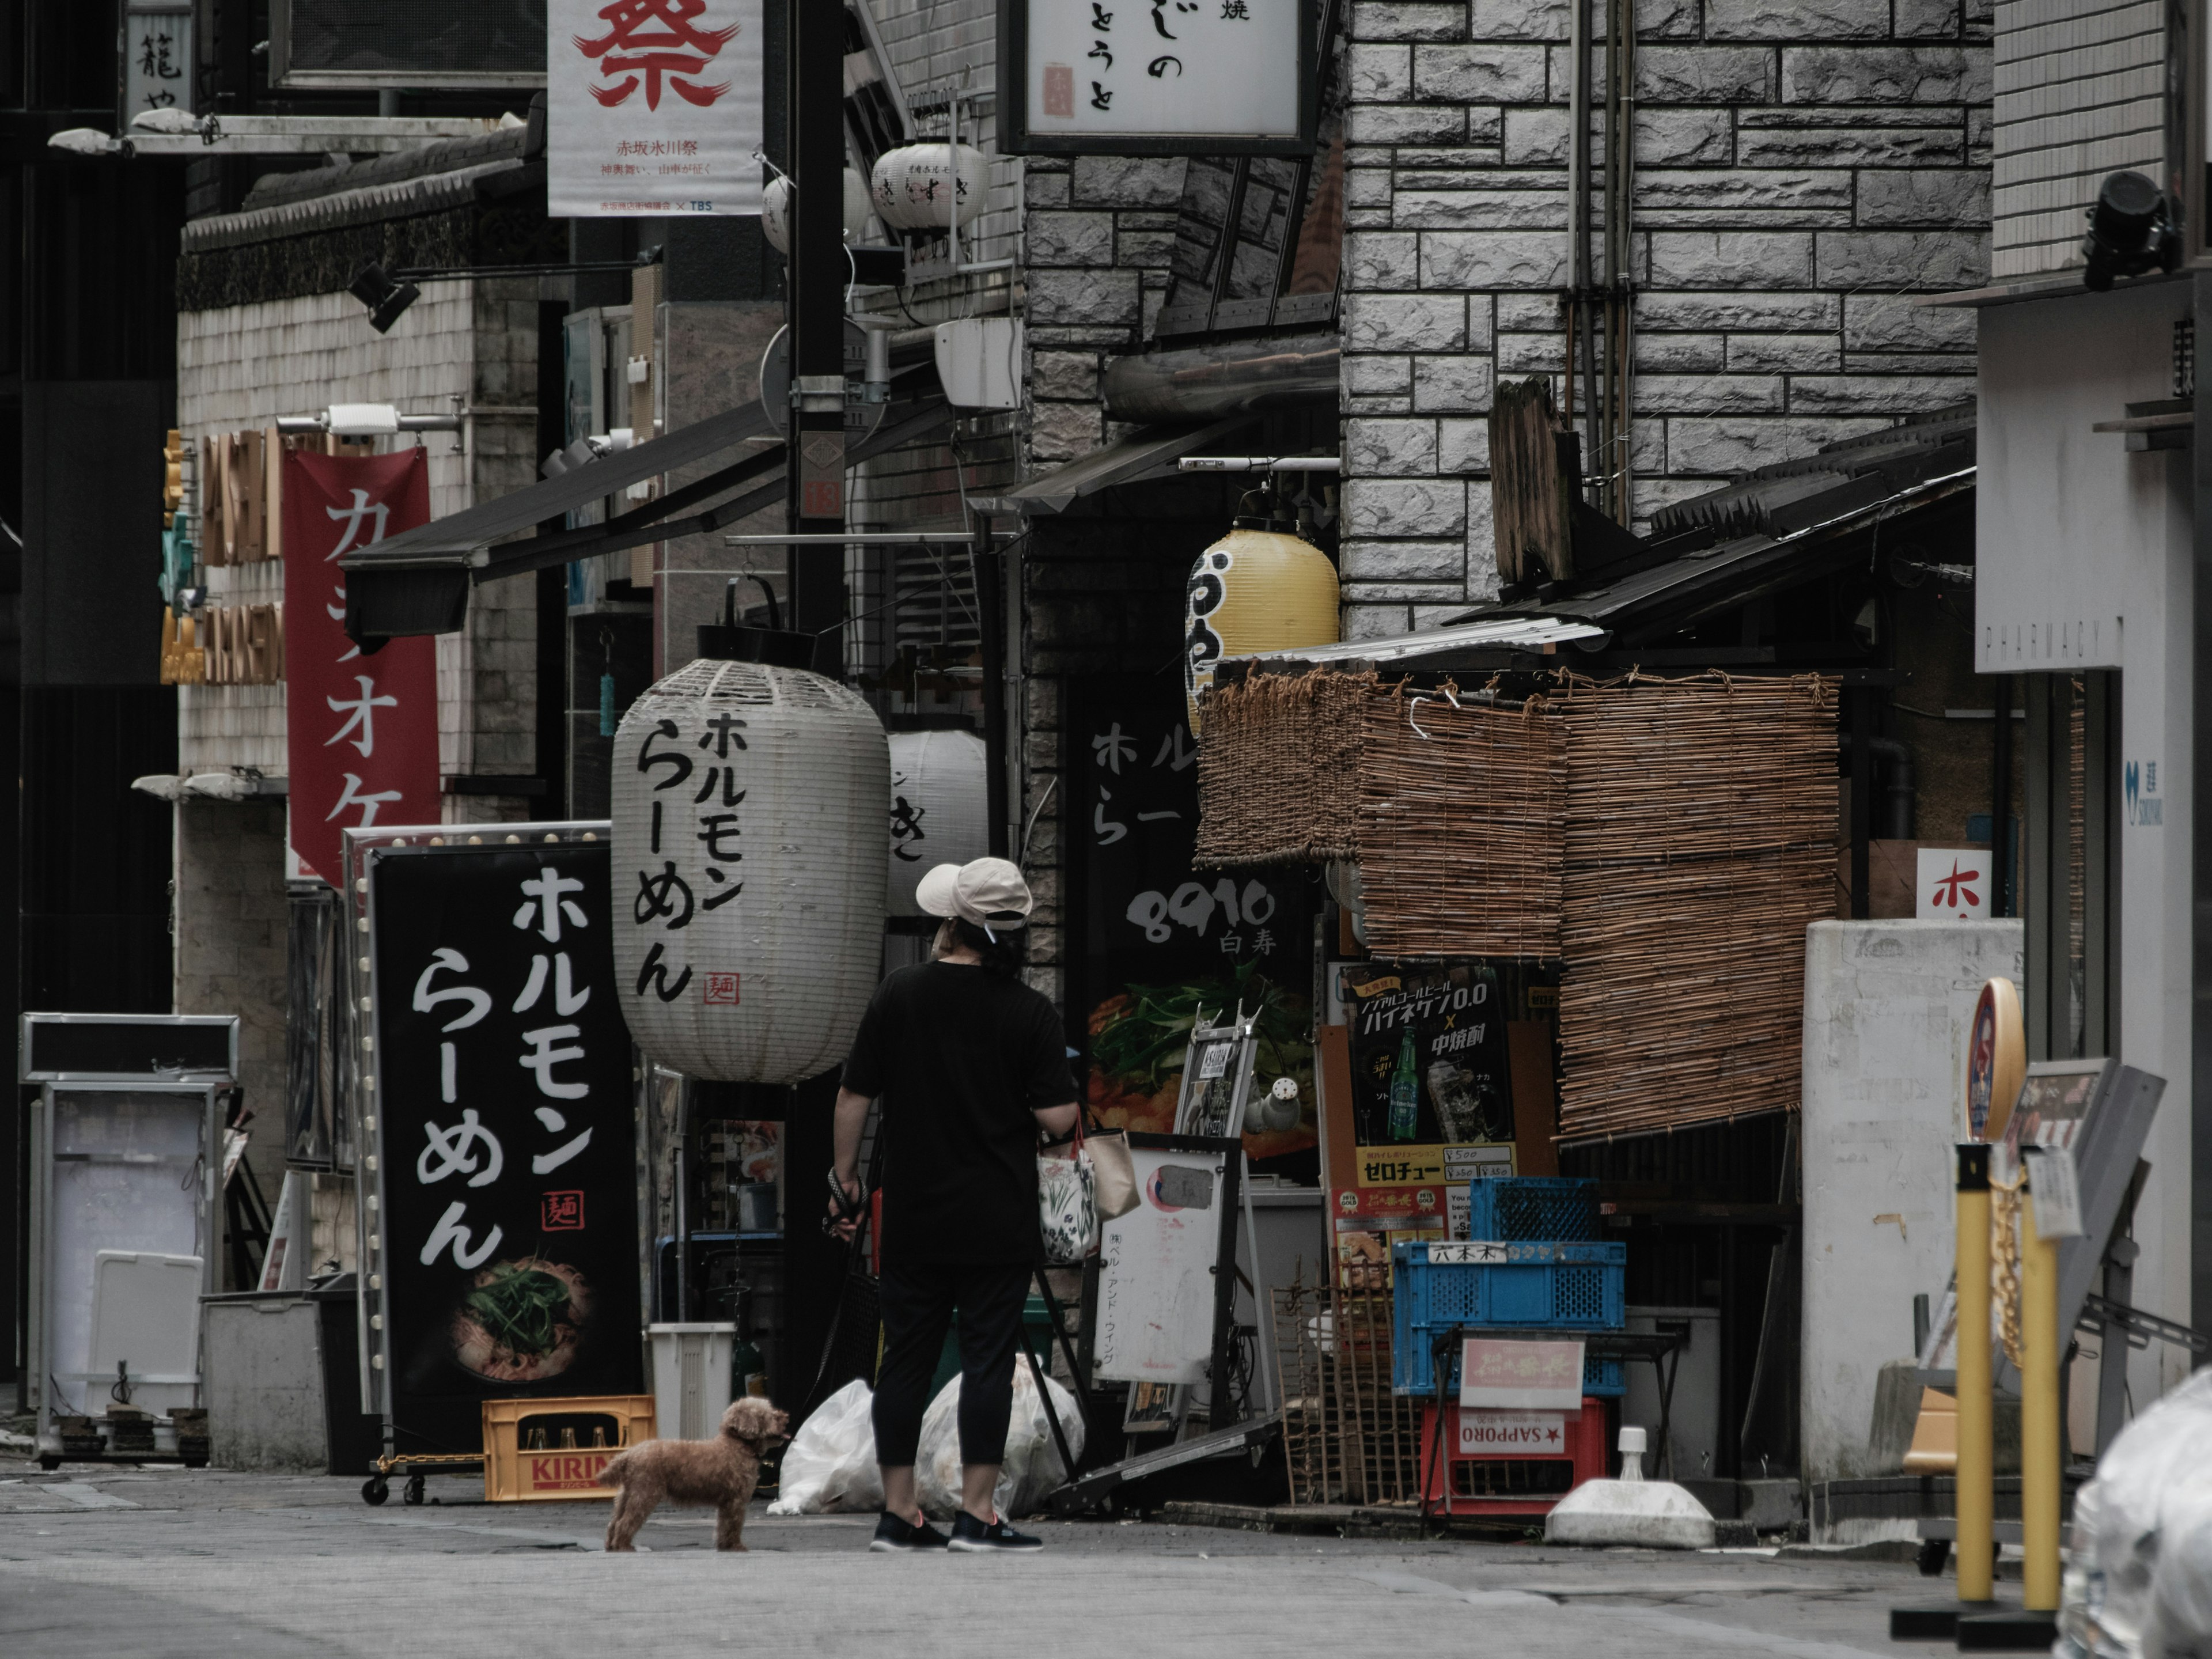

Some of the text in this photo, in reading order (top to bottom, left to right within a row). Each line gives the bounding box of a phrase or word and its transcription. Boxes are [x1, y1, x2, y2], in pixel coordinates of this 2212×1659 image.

[571, 0, 743, 112] 祭
[616, 140, 698, 156] 赤坂氷川祭
[690, 201, 713, 211] TBS
[324, 488, 403, 828] カオケ
[695, 713, 747, 911] ホルモン
[634, 719, 695, 1003] らーめん
[1933, 857, 1980, 918] ホ
[1126, 878, 1275, 944] 8910
[1219, 929, 1277, 955] 白寿
[1361, 980, 1452, 1015] ノンアルコールビール
[1531, 995, 1559, 1005] ゼロチ
[513, 867, 593, 1175] ホルモン
[1431, 1022, 1486, 1056] 中焼酎
[1476, 1073, 1490, 1081] ナカ
[413, 948, 503, 1270] らーめん
[1376, 1092, 1389, 1101] ソト
[1364, 1162, 1441, 1181] ゼロチュー
[1462, 1427, 1542, 1443] SAPPORO
